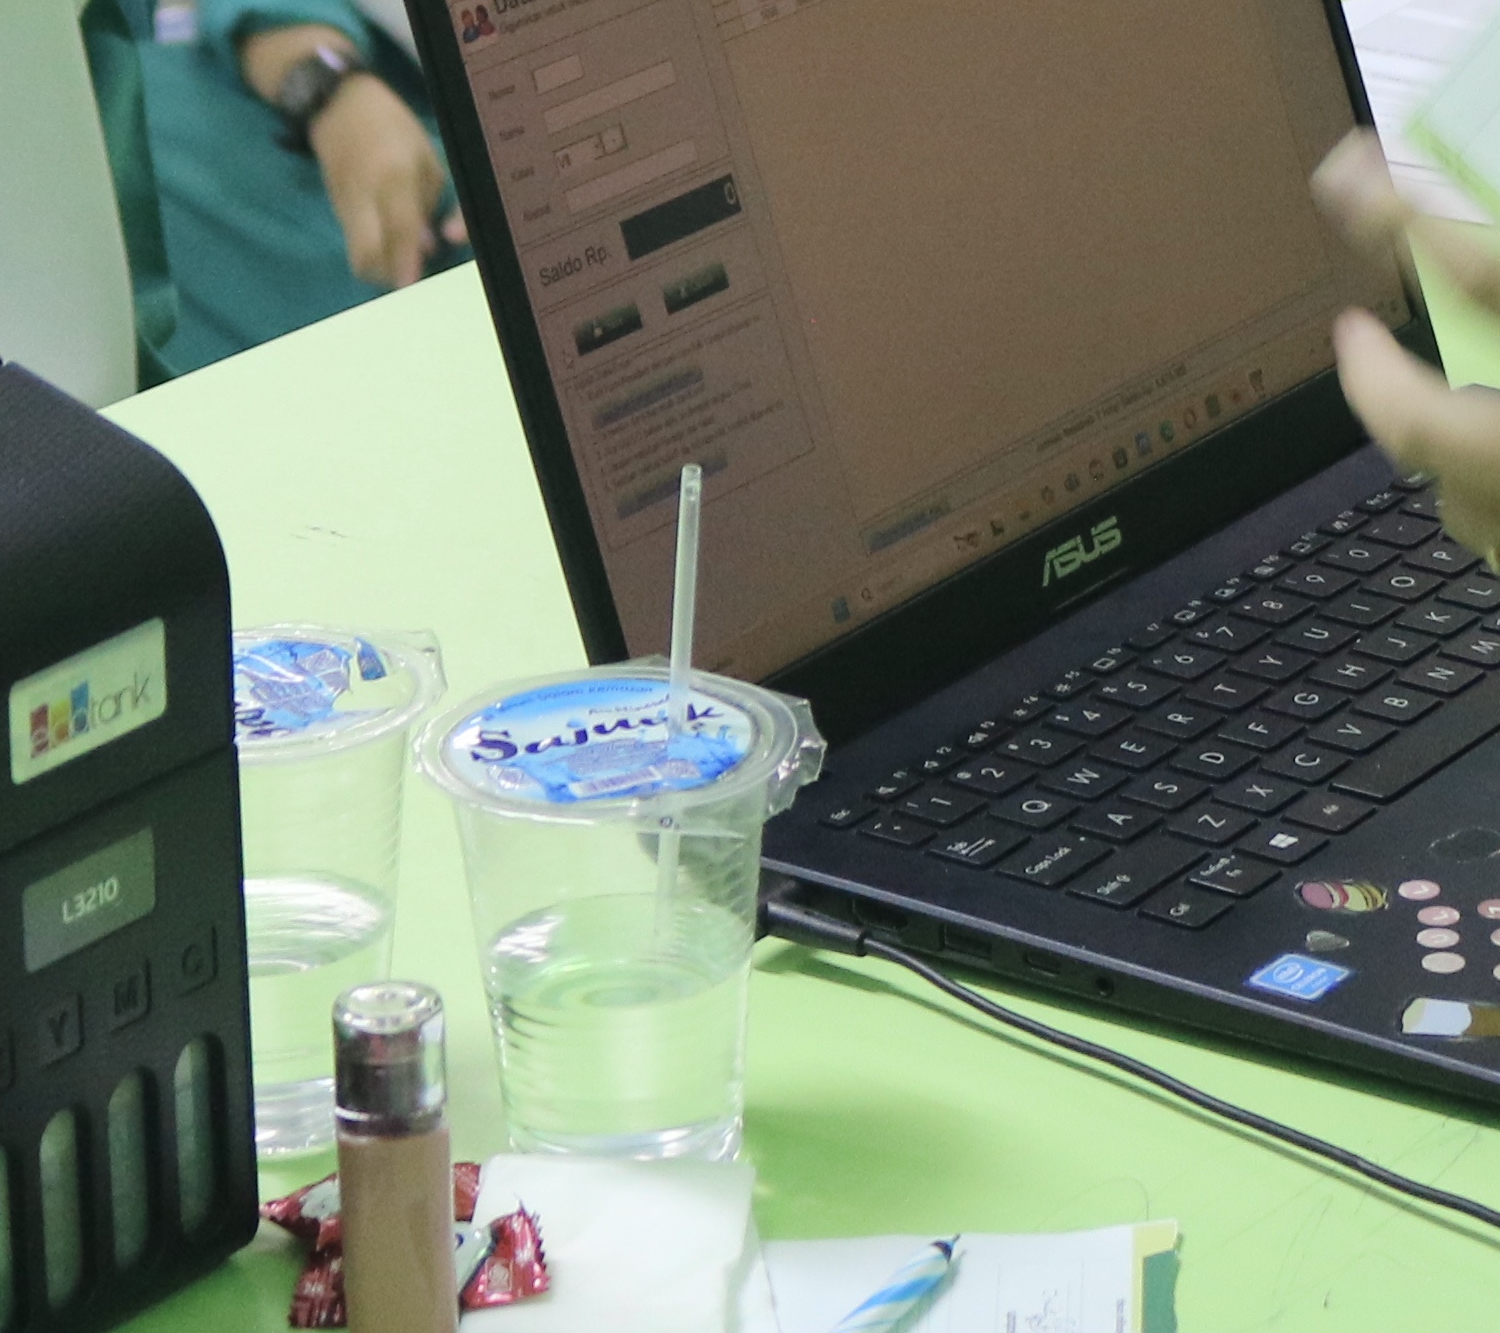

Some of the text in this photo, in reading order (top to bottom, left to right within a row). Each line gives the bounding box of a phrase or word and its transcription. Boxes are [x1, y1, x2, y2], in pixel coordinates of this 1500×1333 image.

[537, 251, 584, 289] Saldo
[721, 181, 737, 207] 0
[1042, 515, 1122, 587] ASUS
[931, 797, 951, 805] 1
[981, 768, 1004, 778] 2
[1030, 739, 1051, 749] 3
[1083, 711, 1100, 720] 4
[1128, 682, 1147, 691] 5
[1175, 656, 1194, 664] 6
[1216, 626, 1233, 637] 7
[1263, 601, 1283, 609] 8
[1349, 549, 1369, 557] 0
[1022, 800, 1051, 813] Q
[1068, 768, 1099, 784] W
[1120, 742, 1145, 753] E
[1168, 713, 1193, 723] R
[1214, 684, 1236, 693] T
[1259, 655, 1282, 665] Y
[1304, 628, 1329, 639] U
[1391, 576, 1415, 587] O
[1433, 551, 1451, 560] P
[1108, 814, 1132, 825] A
[1154, 782, 1178, 793] S
[1200, 752, 1224, 764] D
[1248, 723, 1268, 733] F
[1294, 693, 1319, 704] G
[1338, 664, 1365, 676] H
[1388, 638, 1407, 648] J
[1425, 612, 1450, 622] K
[1198, 641, 1499, 828] Z X C V B N M
[61, 876, 119, 925] L3210
